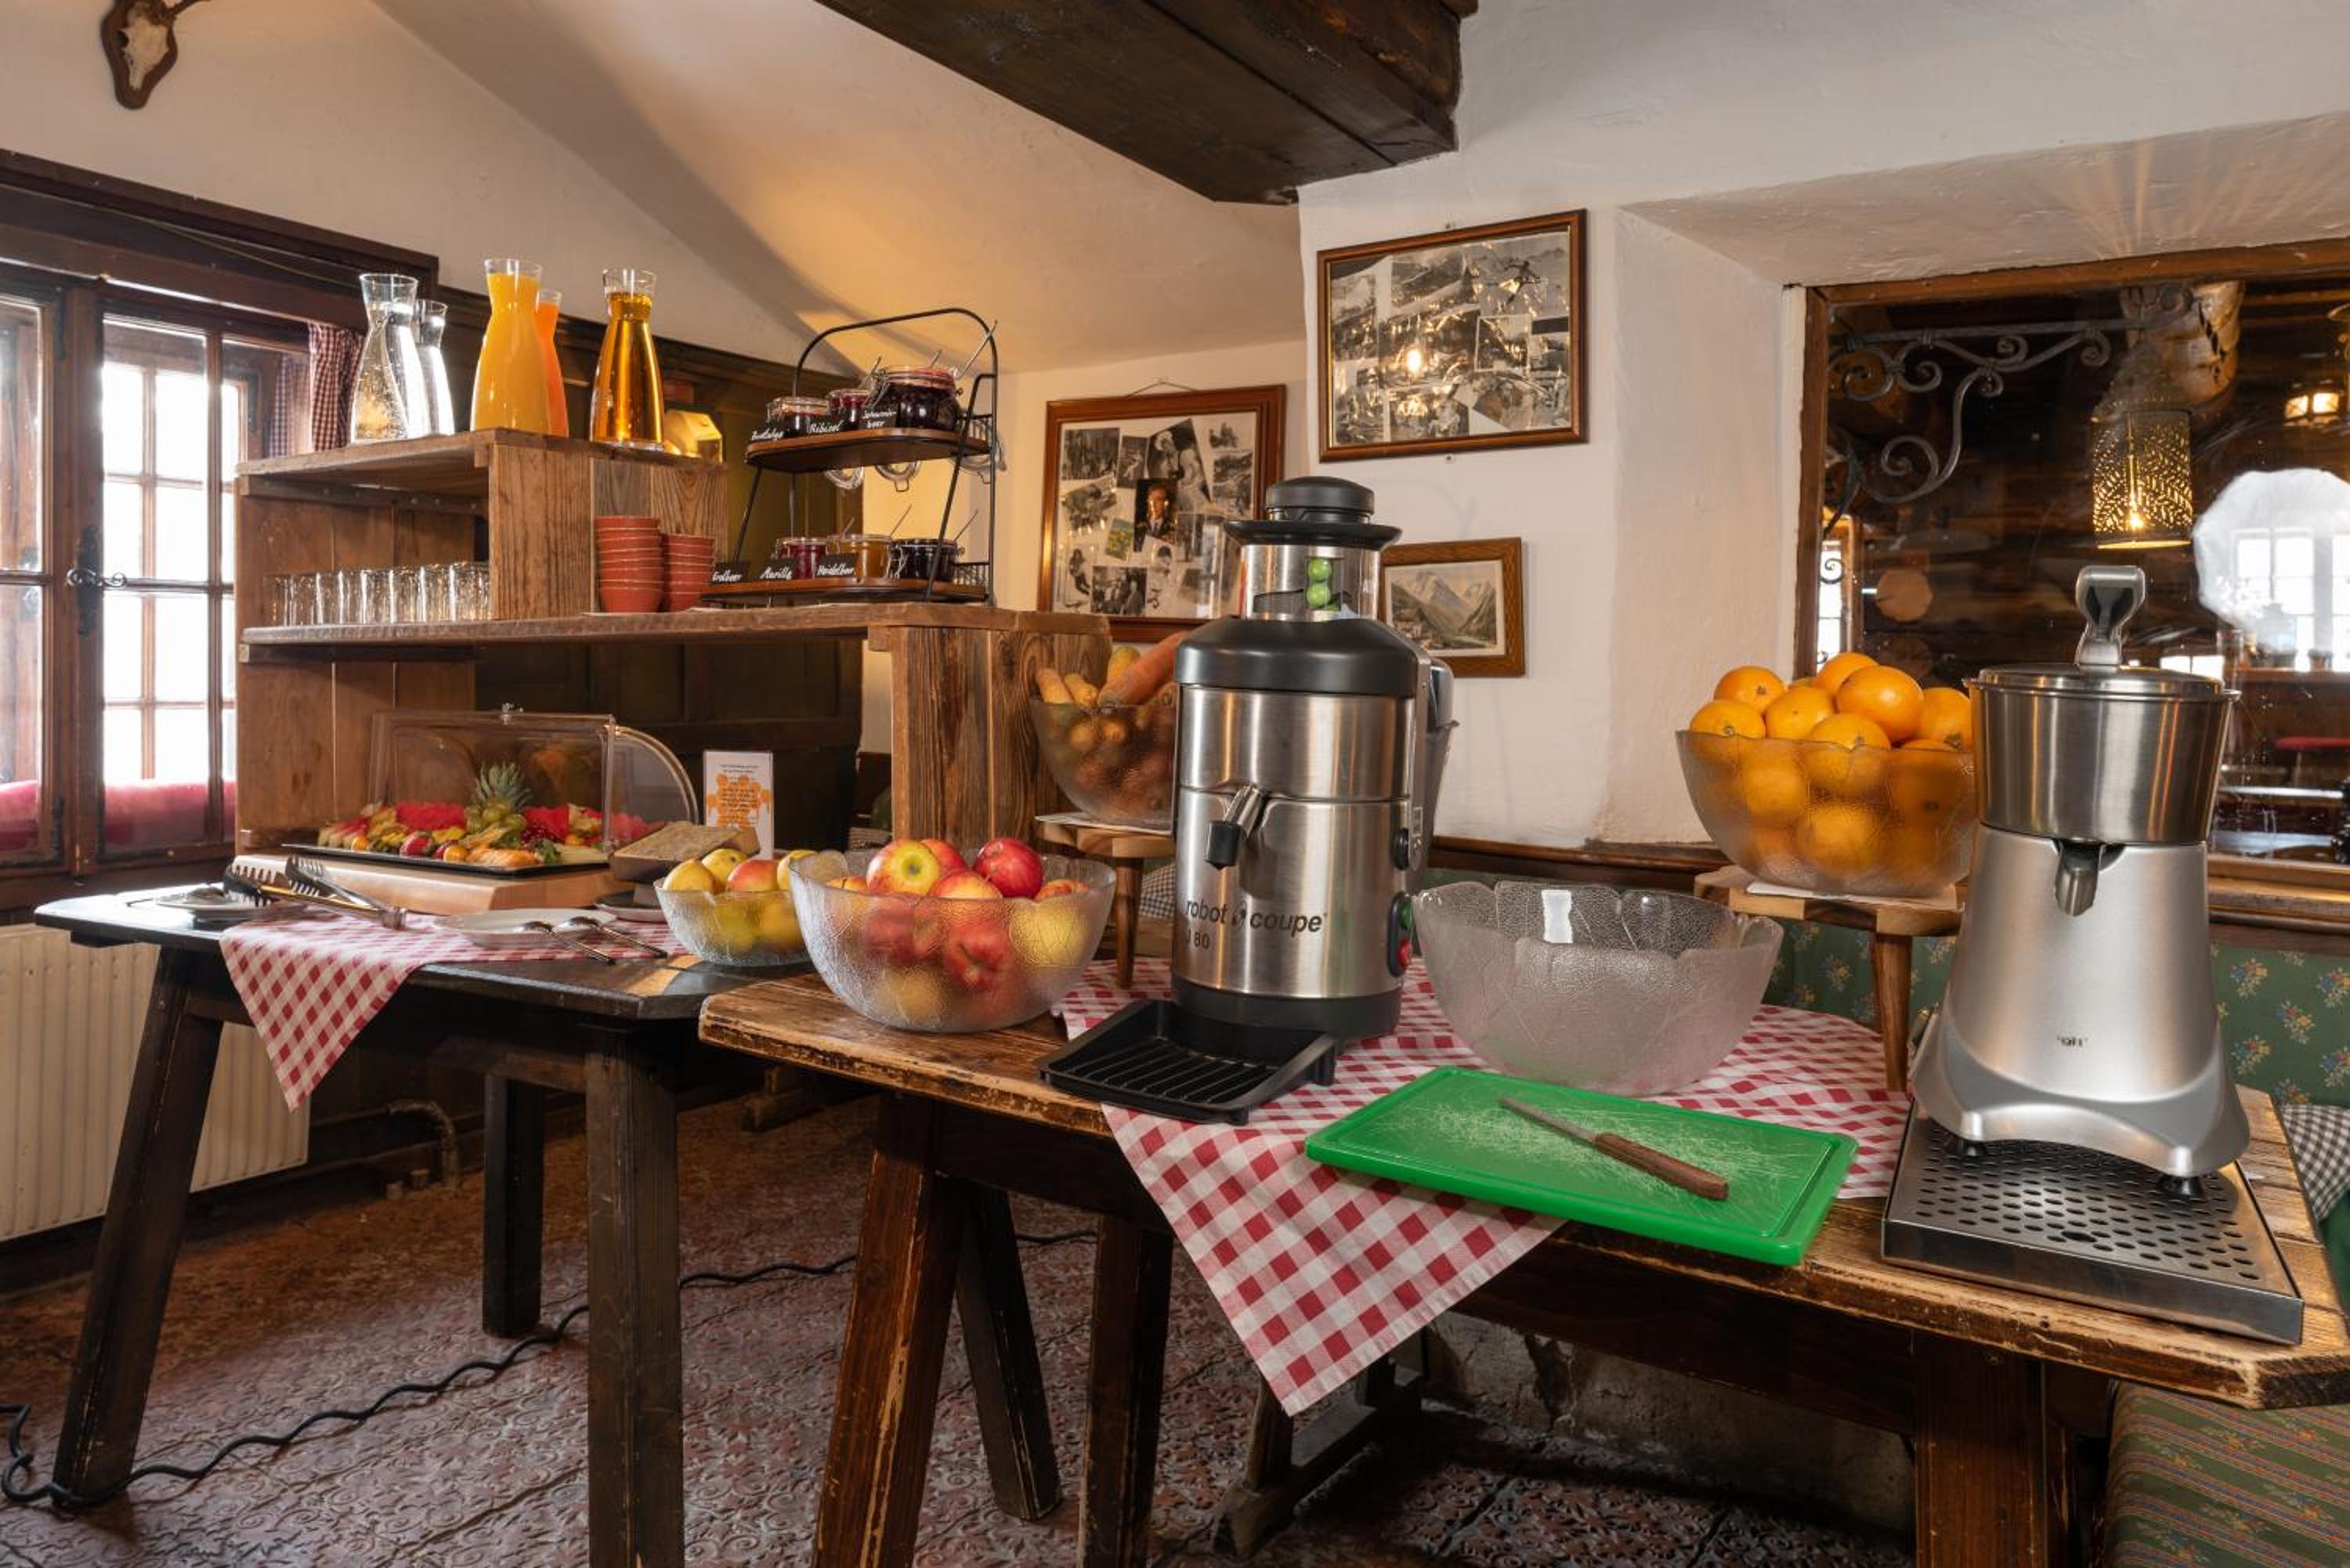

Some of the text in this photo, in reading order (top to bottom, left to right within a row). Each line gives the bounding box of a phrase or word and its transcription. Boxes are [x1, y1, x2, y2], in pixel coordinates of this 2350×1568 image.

[1185, 899, 1322, 938] robot coupe
[1194, 931, 1210, 949] 80
